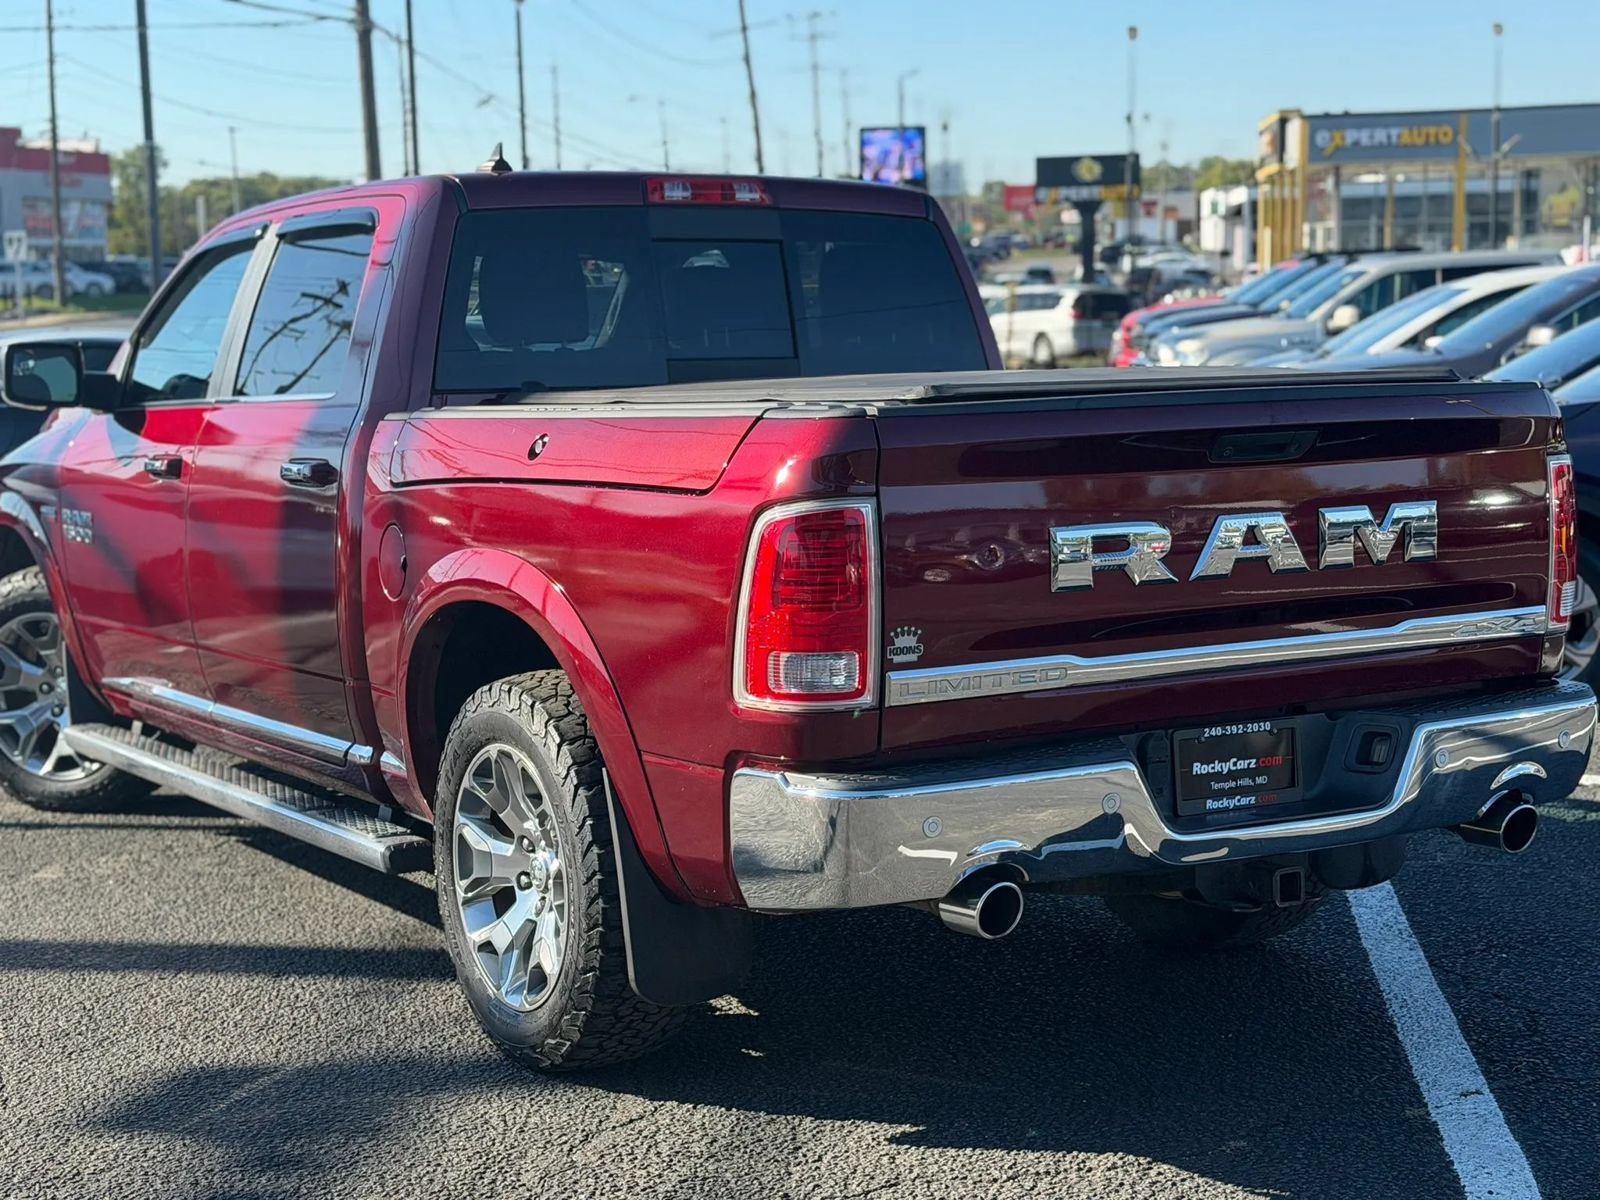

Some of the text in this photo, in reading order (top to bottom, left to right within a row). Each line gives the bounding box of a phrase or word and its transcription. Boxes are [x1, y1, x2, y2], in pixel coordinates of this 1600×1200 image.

[1049, 499, 1439, 594] RAM
[888, 644, 923, 657] KOONS
[899, 667, 1068, 697] LIMITED
[1203, 721, 1271, 738] 240-392-2030
[1210, 775, 1268, 791] Temple Hills, MD
